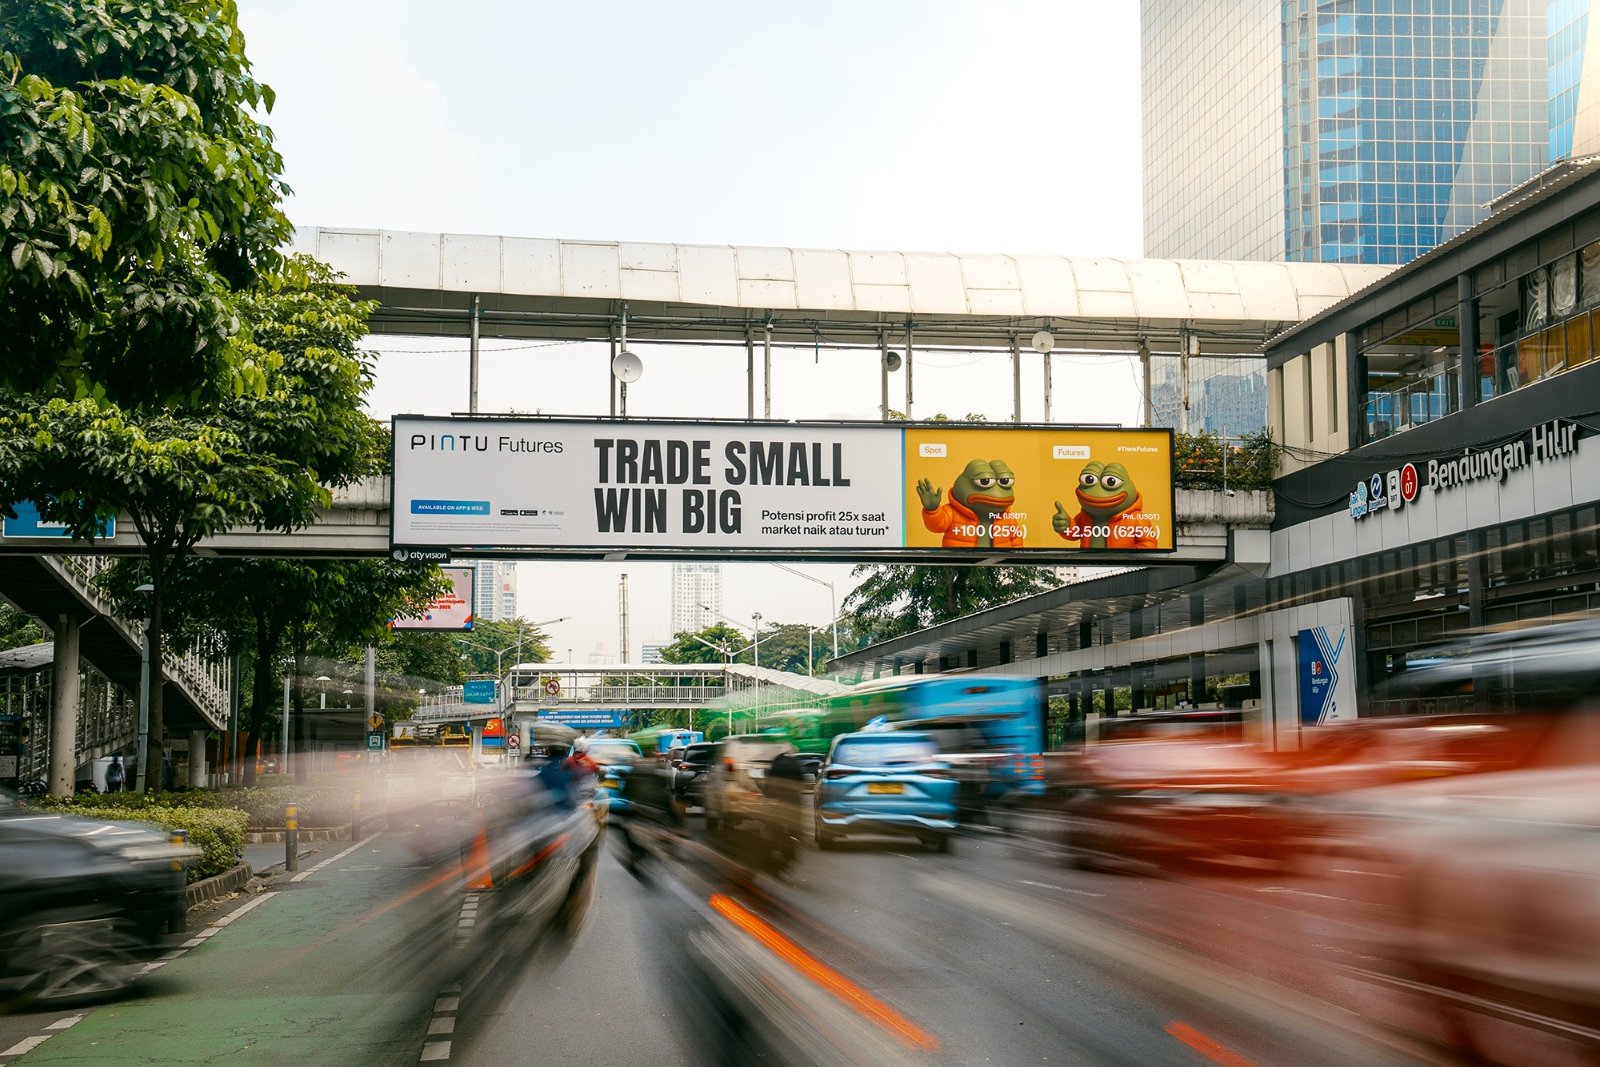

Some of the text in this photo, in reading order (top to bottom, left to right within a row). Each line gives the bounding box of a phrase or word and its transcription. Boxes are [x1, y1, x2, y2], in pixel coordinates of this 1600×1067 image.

[410, 434, 564, 454] PINTU Futures
[924, 446, 942, 456] Spot
[1116, 445, 1158, 453] #ThinkFutures
[1057, 448, 1085, 458] Futures
[1428, 419, 1577, 492] Bendungan Hilir
[594, 438, 851, 487] TRADE SMALL
[1405, 481, 1413, 495] 07
[594, 488, 742, 534] WIN BIG
[761, 509, 886, 526] Potensi profit 25x saat
[988, 512, 1027, 521] PnL (USDT)
[1122, 513, 1160, 521] PnL (USDT)
[761, 523, 801, 536] market
[803, 523, 827, 536] naik
[828, 525, 854, 536] atau
[952, 525, 1027, 540] +100 (25%)
[1063, 525, 1161, 540] +2.500 (625%)
[410, 551, 447, 561] city vision
